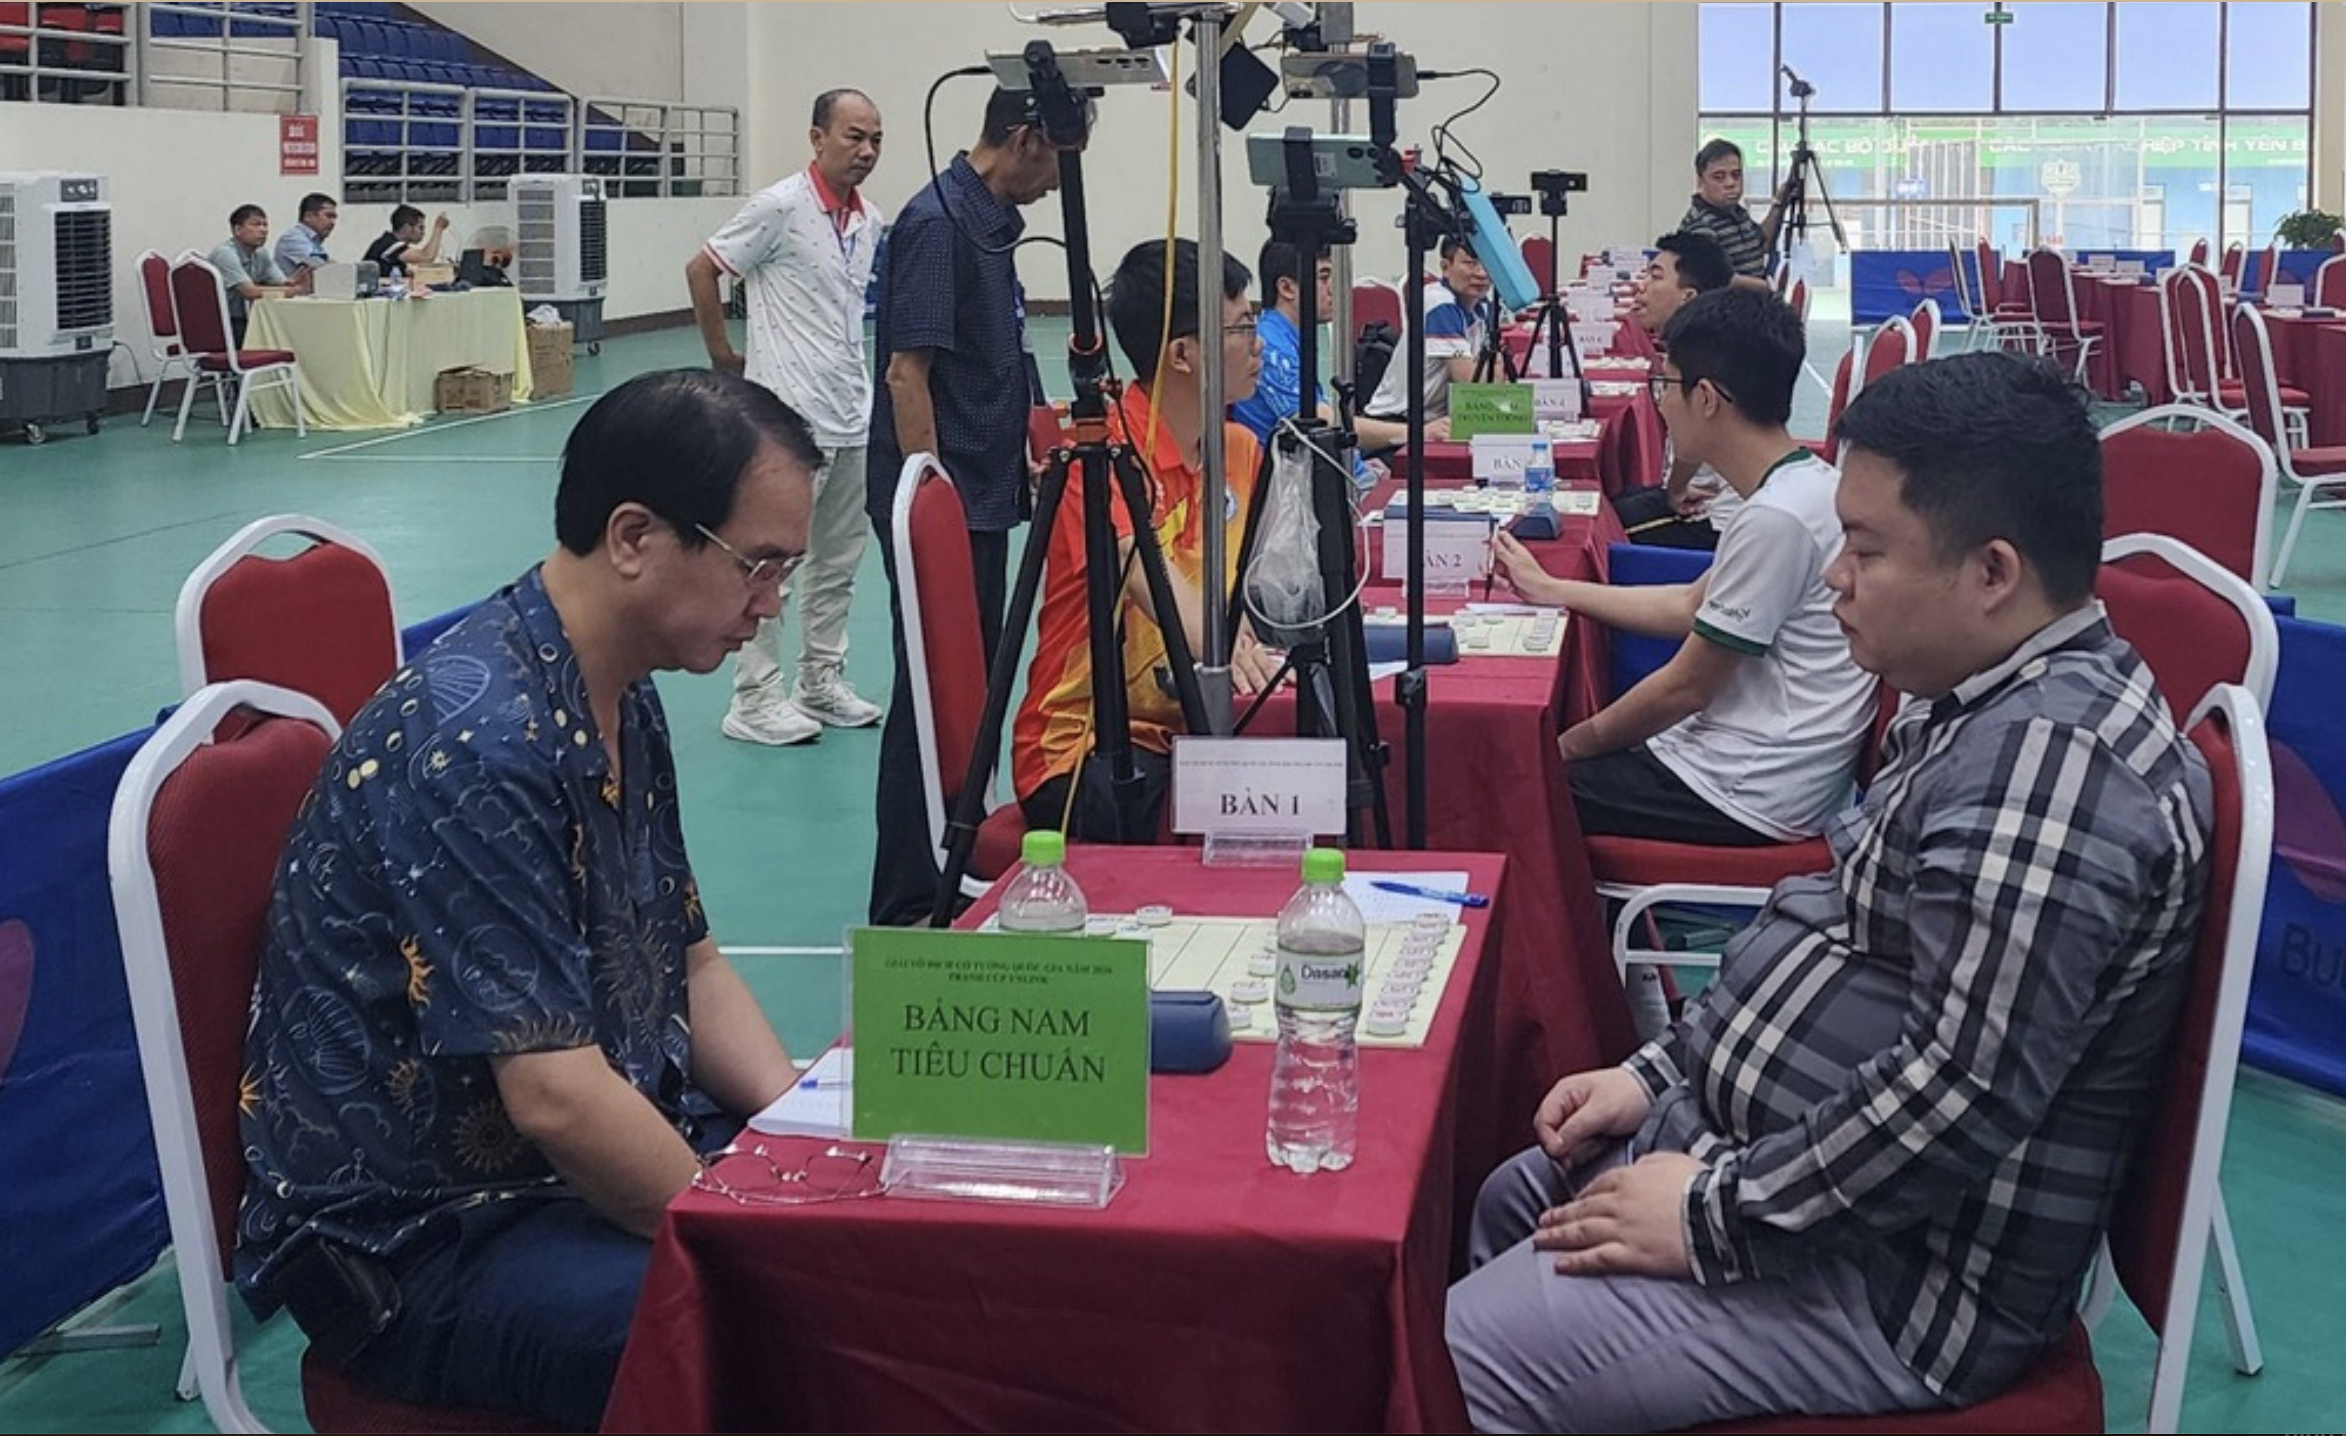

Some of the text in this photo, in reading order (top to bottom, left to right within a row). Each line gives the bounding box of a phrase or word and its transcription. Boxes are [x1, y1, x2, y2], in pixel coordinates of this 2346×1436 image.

[1423, 549, 1462, 568] ÀN 2
[1220, 786, 1300, 816] BÀN 1
[1301, 964, 1354, 980] Dasan
[904, 996, 1090, 1036] BẢNG NAM
[890, 1040, 1106, 1083] TIÊU CHUẨN
